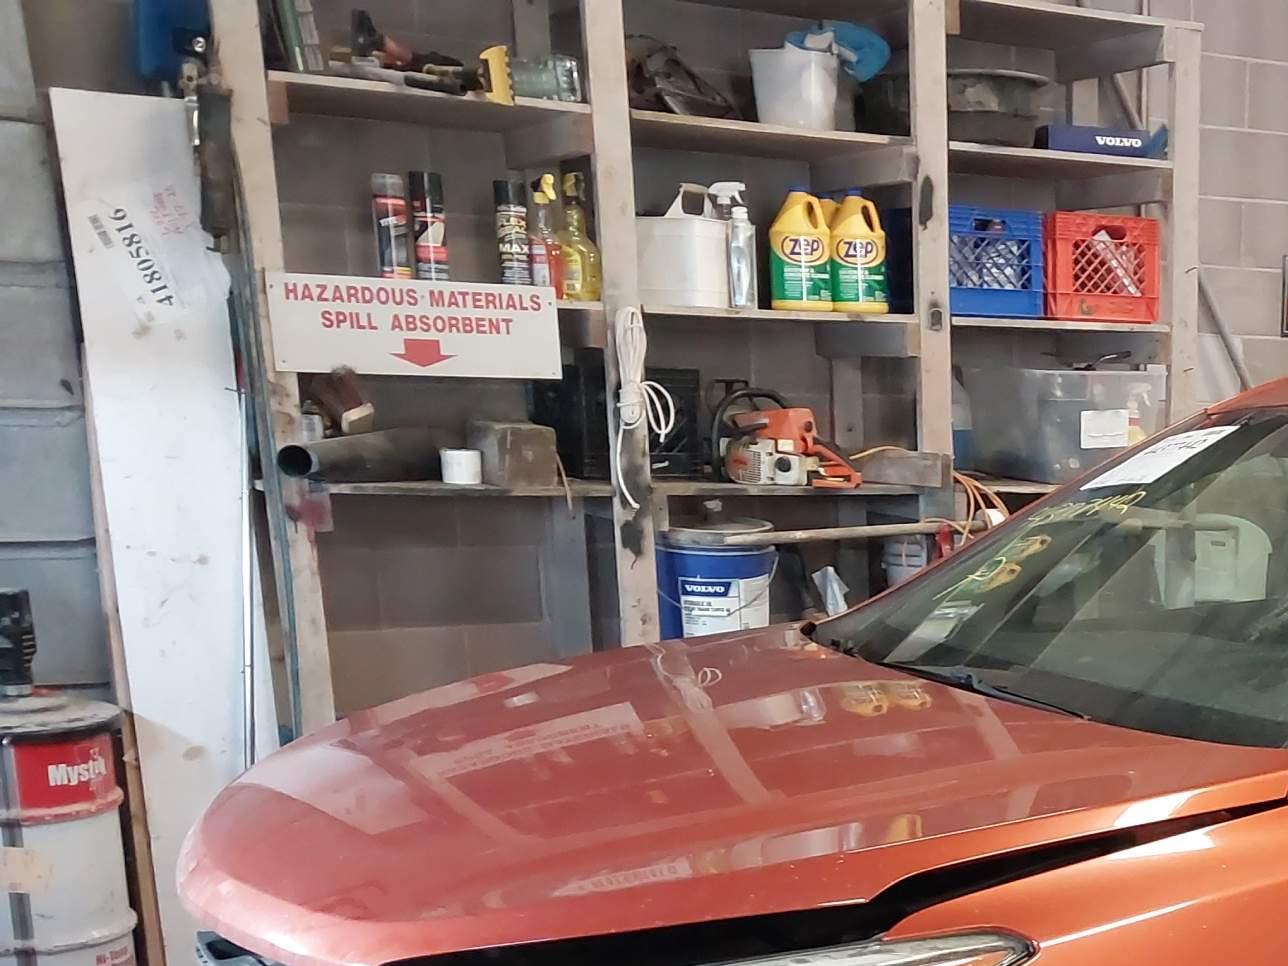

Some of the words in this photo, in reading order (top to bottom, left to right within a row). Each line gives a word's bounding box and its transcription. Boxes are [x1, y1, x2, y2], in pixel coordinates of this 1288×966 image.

[1095, 135, 1142, 148] VOLVO
[109, 207, 174, 306] 41805816
[499, 243, 529, 253] MAX
[284, 281, 419, 306] HAZARDOUS
[429, 289, 542, 312] MATERIALS
[321, 310, 378, 331] SPILL
[390, 313, 514, 335] ABSORBENT
[684, 584, 726, 594] VOLVO
